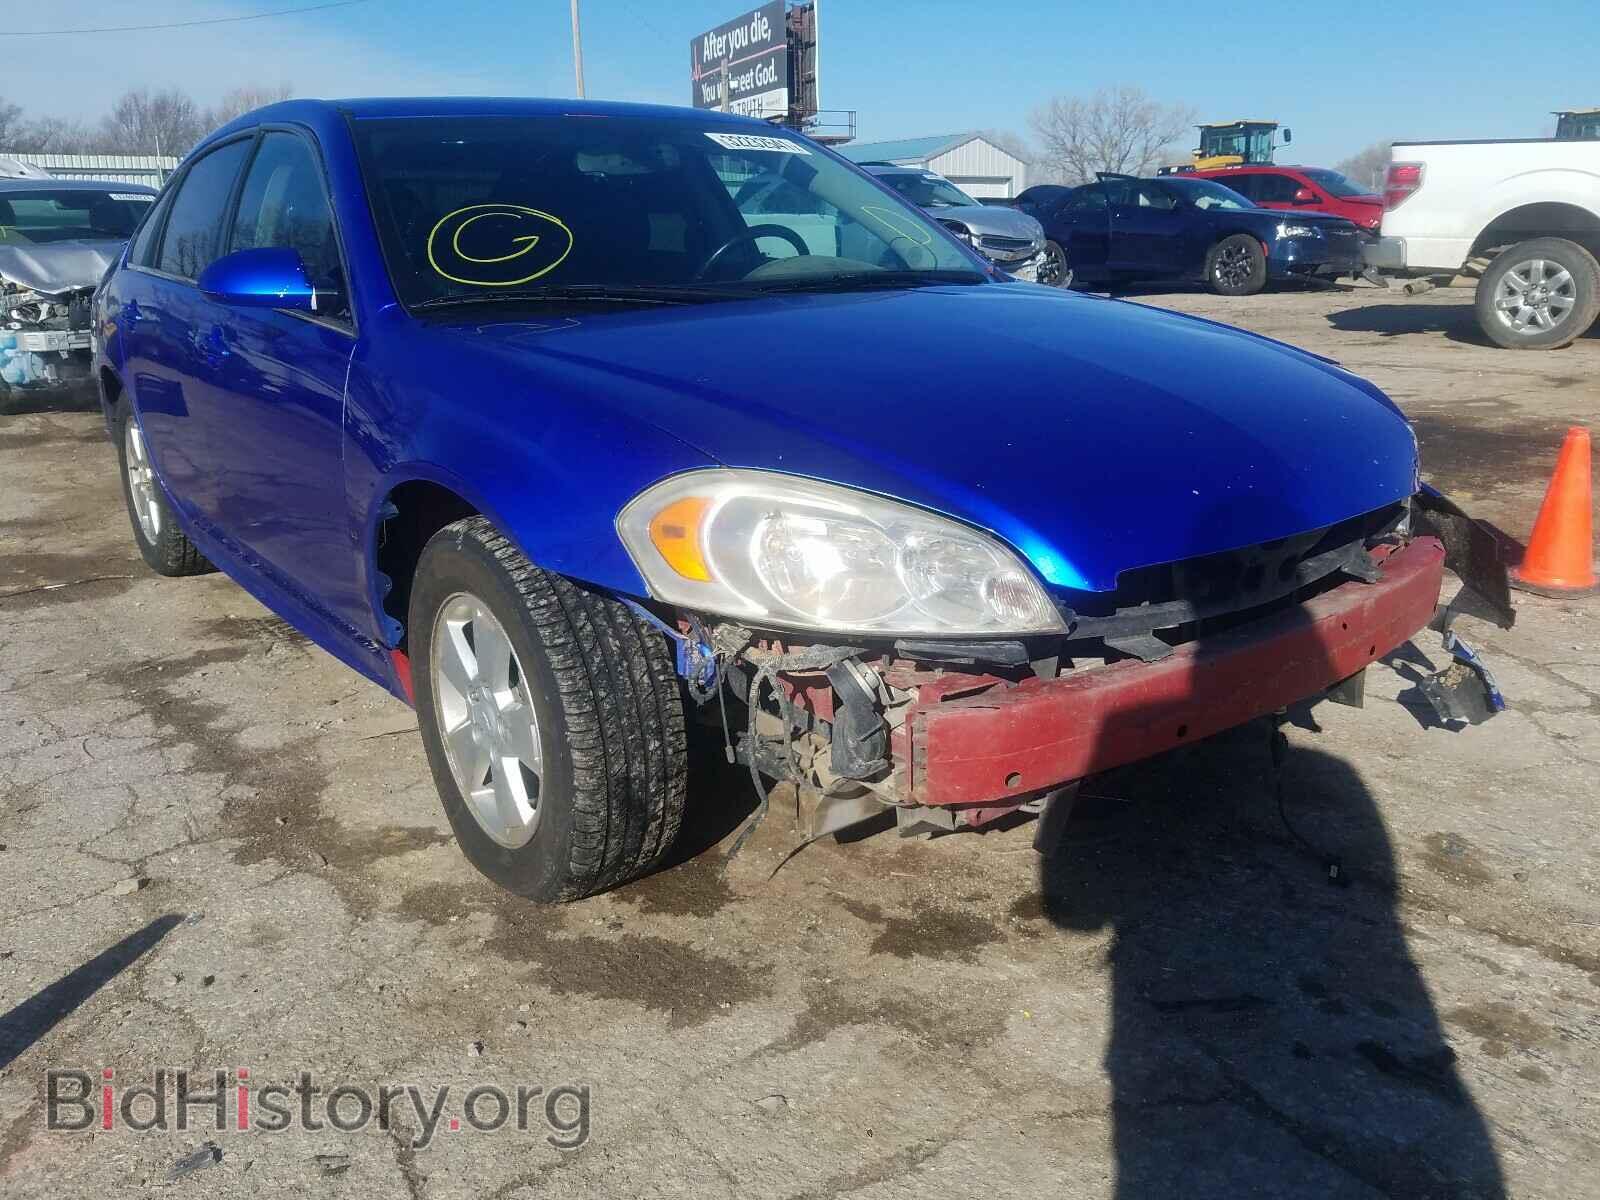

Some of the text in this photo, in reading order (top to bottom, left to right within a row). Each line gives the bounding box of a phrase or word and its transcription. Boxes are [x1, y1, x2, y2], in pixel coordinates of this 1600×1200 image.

[703, 12, 771, 63] After you die,
[702, 83, 716, 104] You
[755, 57, 777, 87] God.
